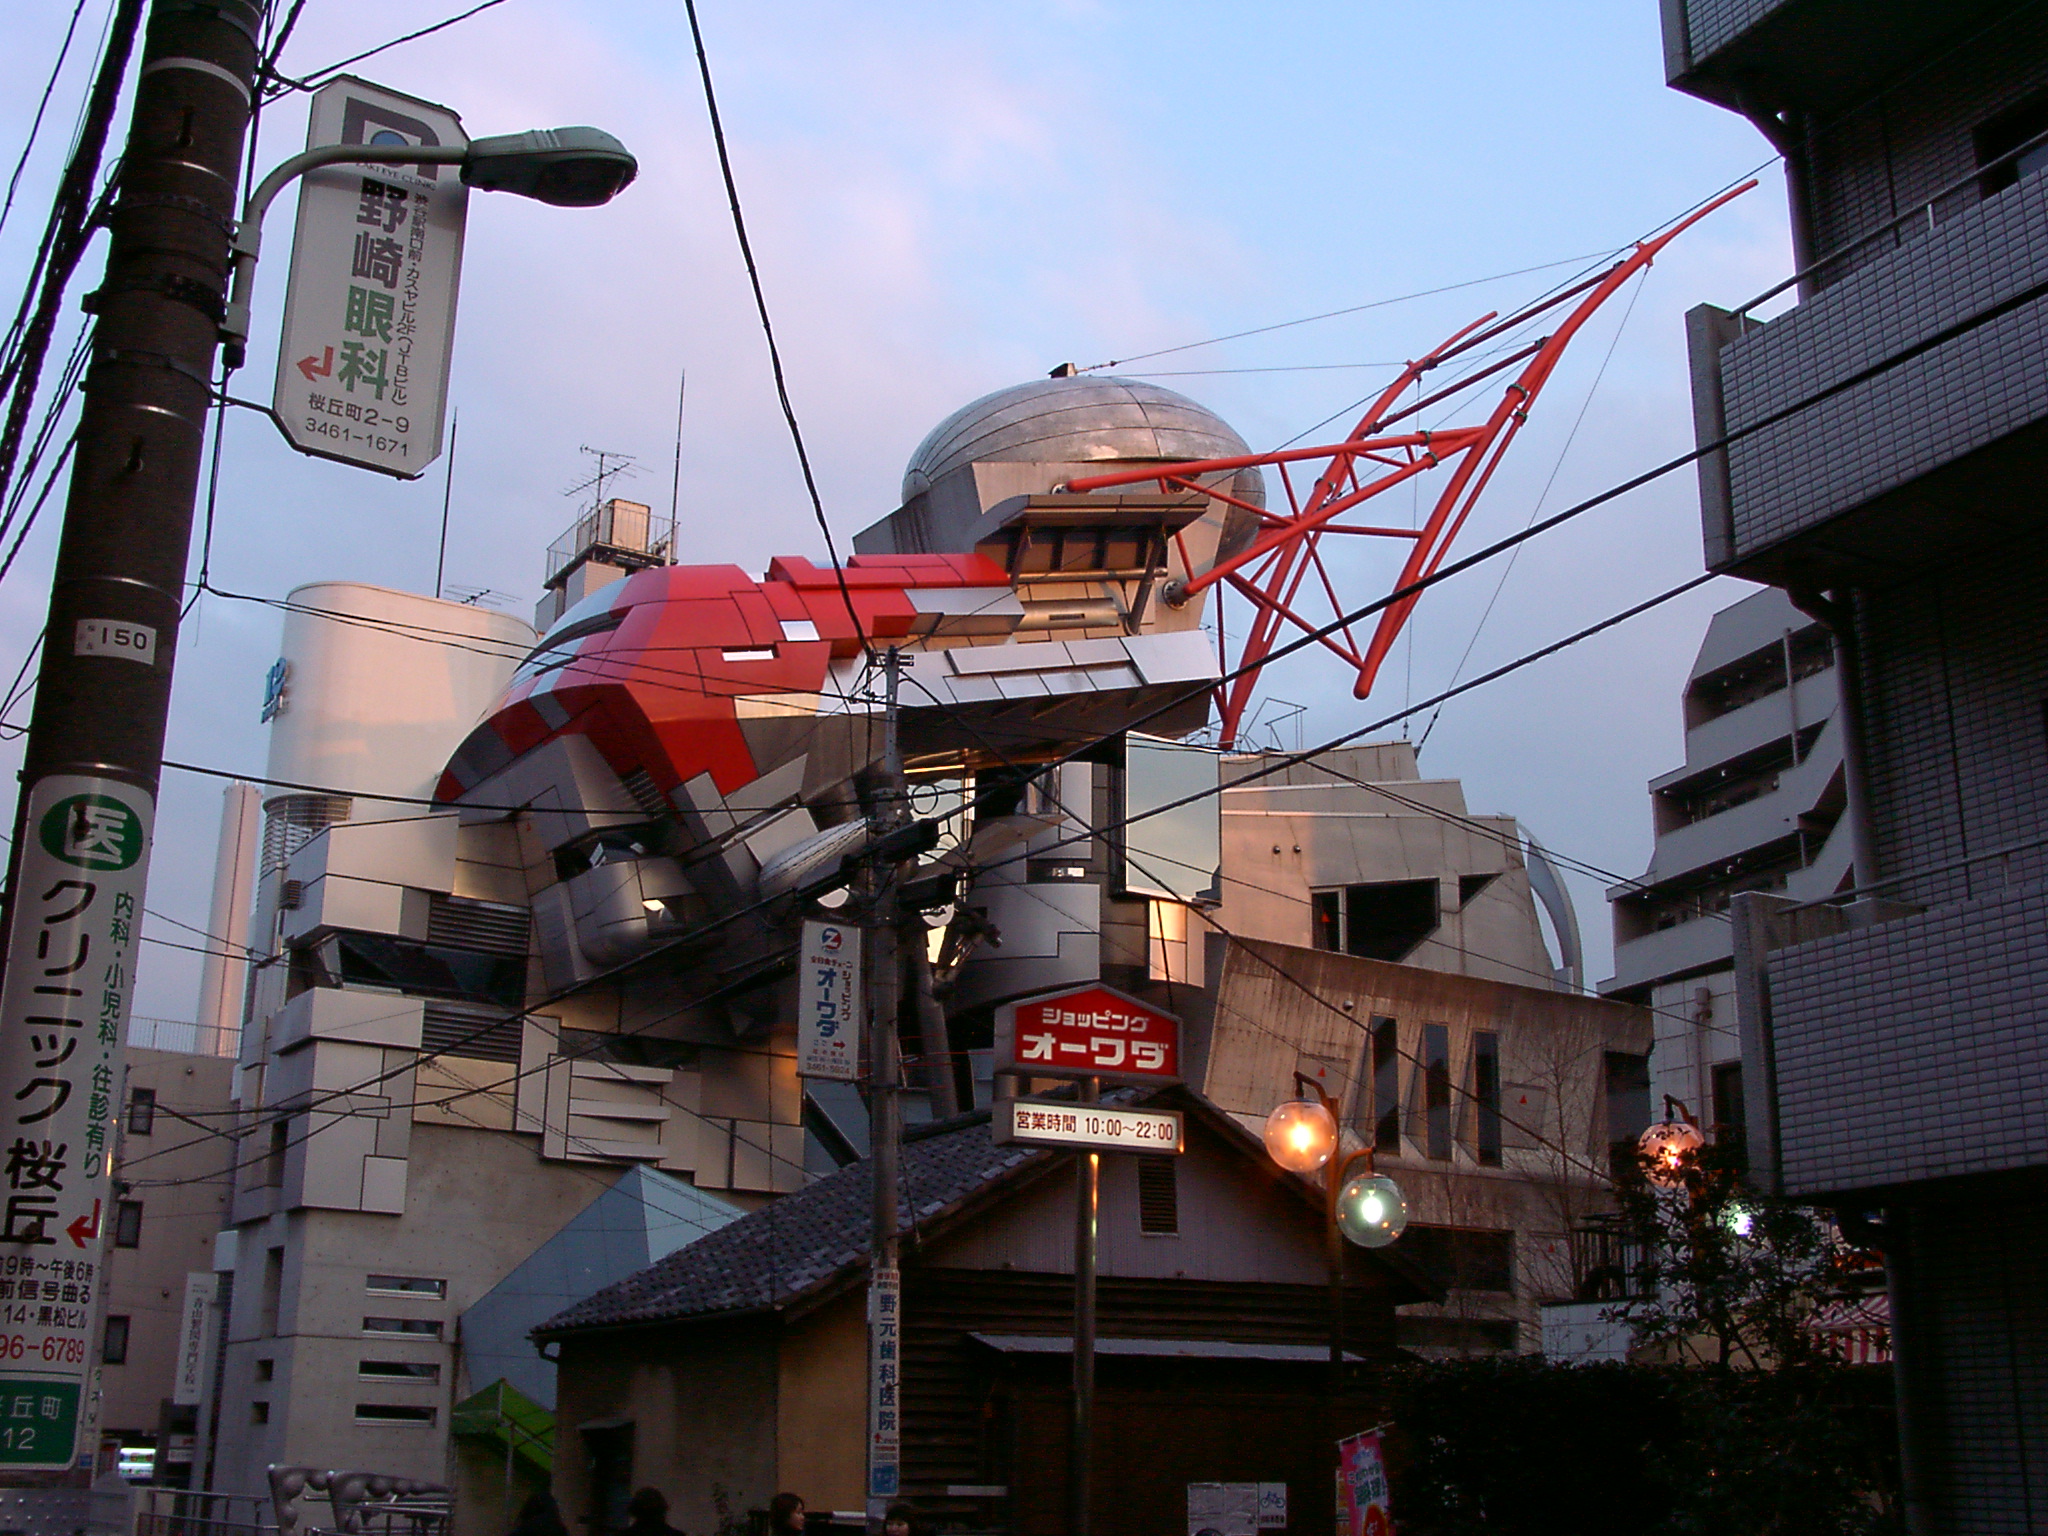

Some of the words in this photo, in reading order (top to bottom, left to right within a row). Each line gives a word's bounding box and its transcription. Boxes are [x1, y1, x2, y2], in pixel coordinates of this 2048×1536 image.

[402, 175, 437, 191] CLINIC
[337, 177, 408, 400] 野崎眼科
[308, 393, 410, 434] 桜丘町2-9
[305, 417, 409, 457] 3461-1671
[102, 627, 147, 650] 150
[64, 803, 128, 865] 医
[816, 967, 840, 1038] オーワダ
[1042, 1007, 1150, 1033] ショッピング
[1022, 1032, 1169, 1070] オーワダ
[1016, 1110, 1077, 1134] 営業時間
[0, 1256, 94, 1283] 9時〜午後6時
[878, 1293, 898, 1432] 野元歯科医院
[0, 1396, 62, 1420] 丘町
[3, 1428, 36, 1449] 12
